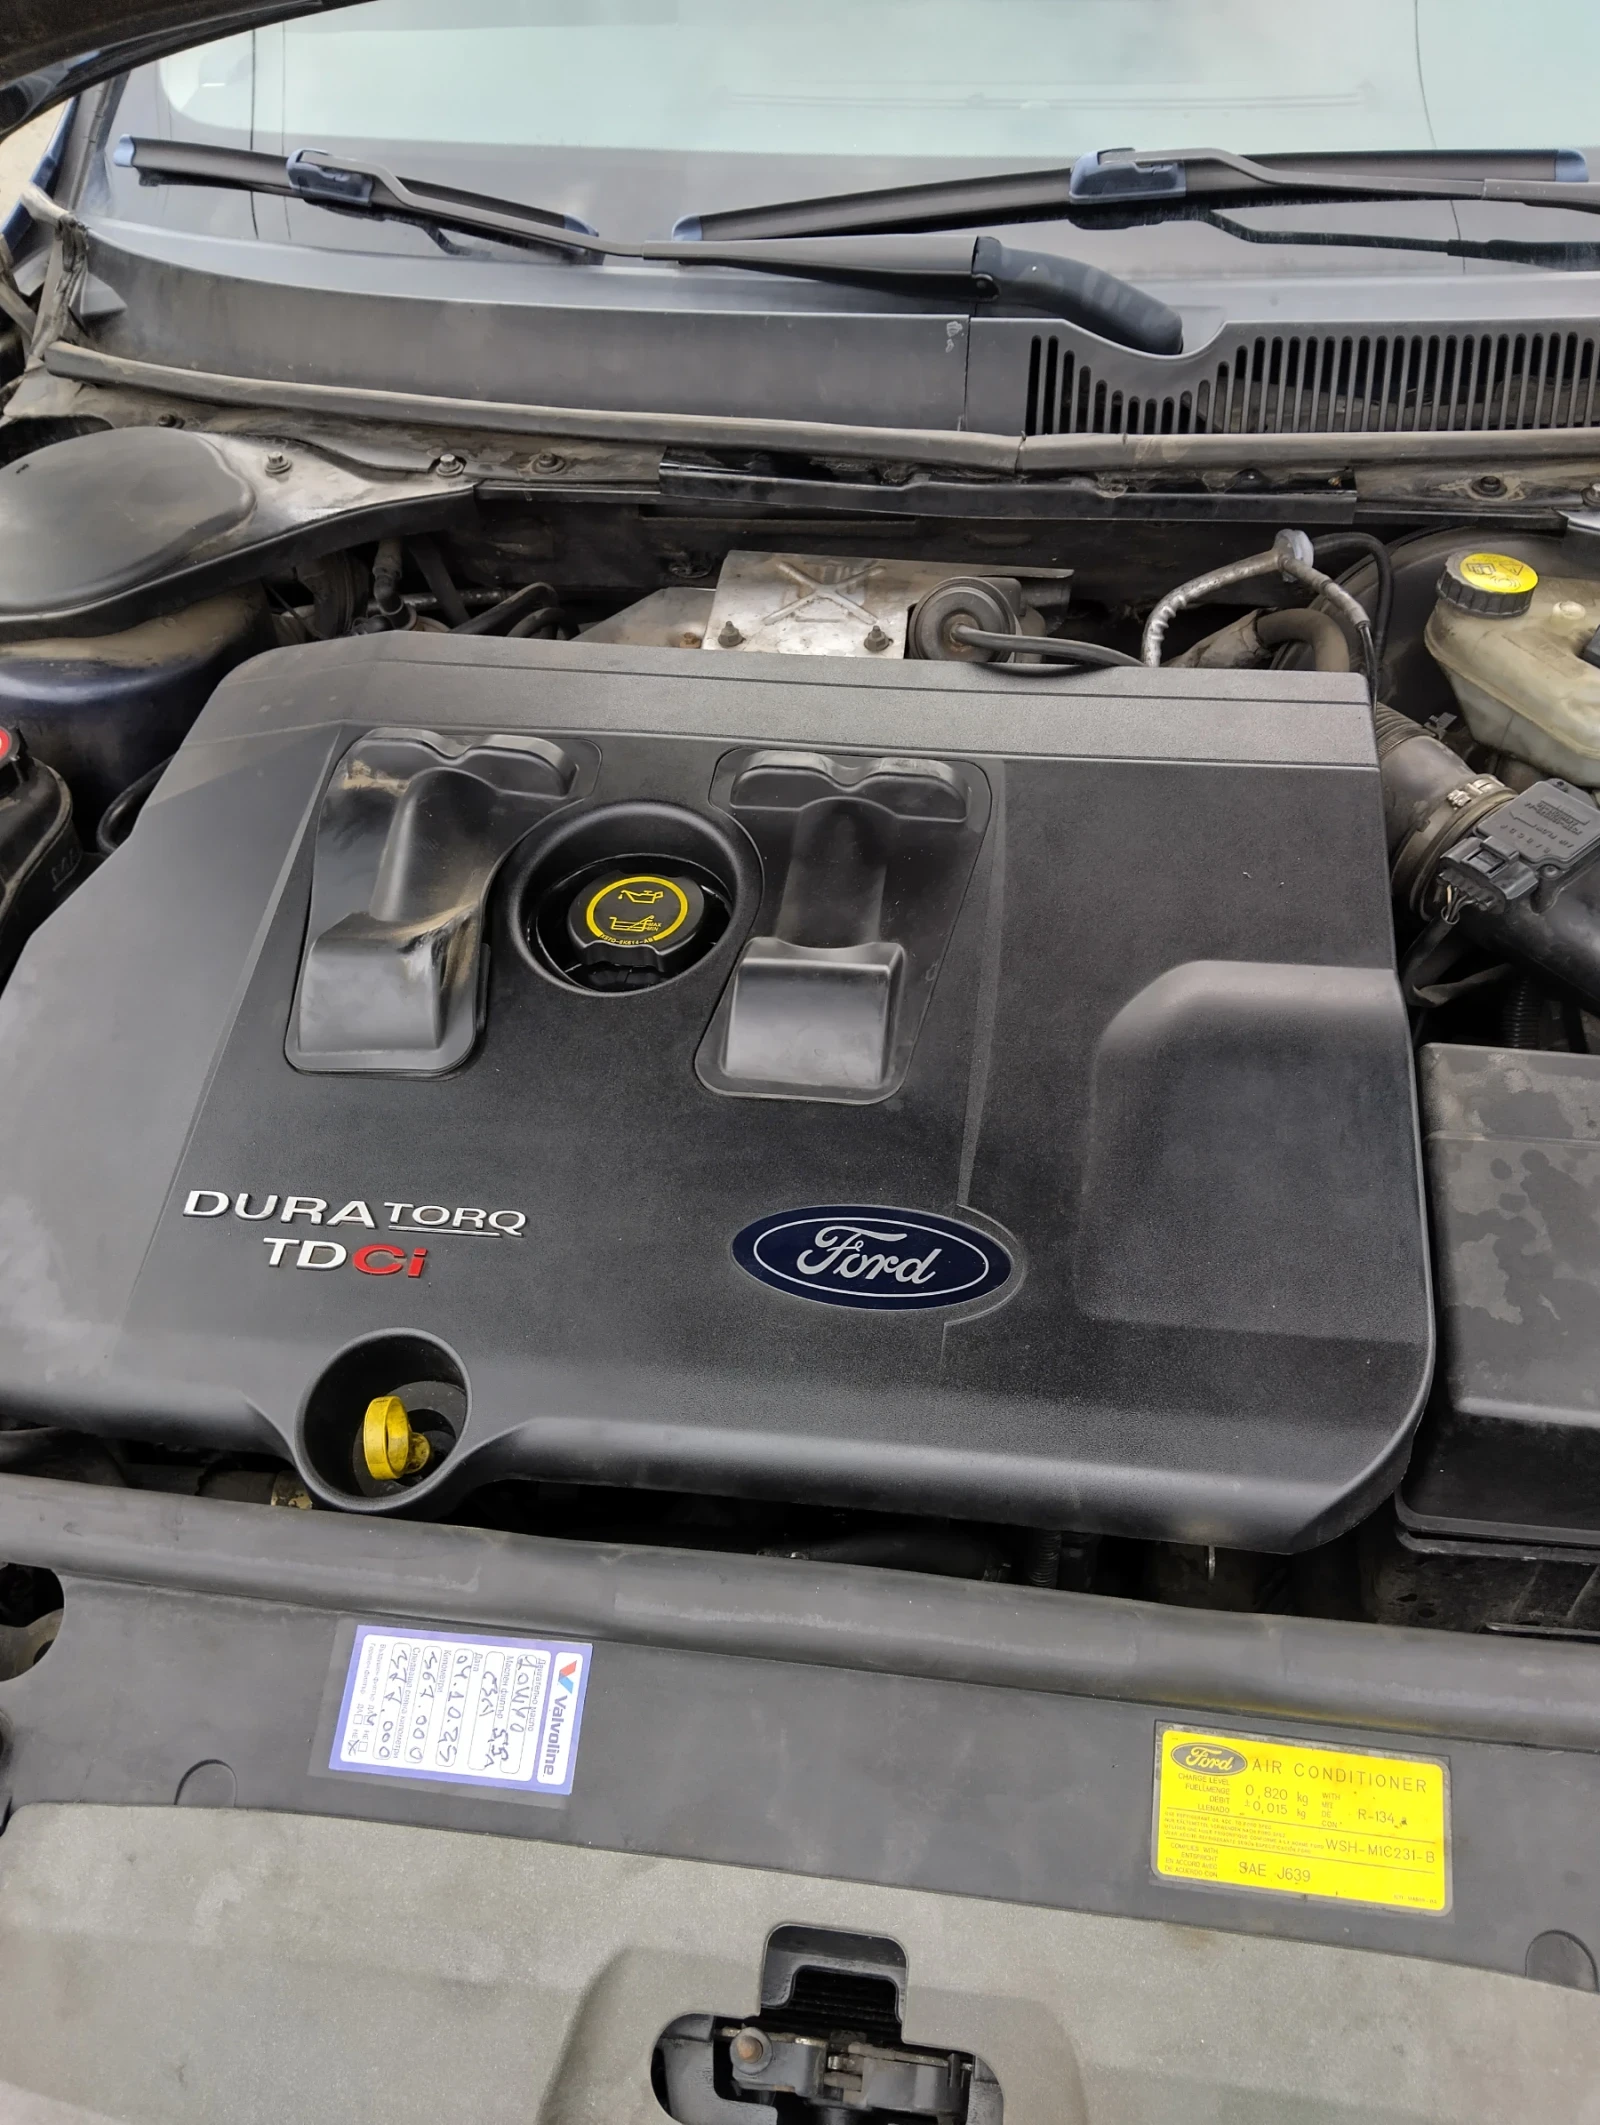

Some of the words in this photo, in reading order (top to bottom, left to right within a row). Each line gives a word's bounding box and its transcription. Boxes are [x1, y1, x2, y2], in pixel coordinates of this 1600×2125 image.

[263, 1237, 428, 1278] TDCi
[796, 1226, 942, 1284] Ford
[473, 1652, 483, 1672] Дата
[502, 1656, 514, 1686] Маслен
[544, 1695, 568, 1776] Valvoline
[1186, 1746, 1235, 1771] Ford
[1178, 1772, 1207, 1782] CHARGE
[1209, 1777, 1230, 1785] LEVEL
[1252, 1758, 1282, 1774] AIR
[1294, 1763, 1427, 1793] CONDITIONER
[1185, 1783, 1231, 1795] FUELLMENGE
[1297, 1791, 1308, 1806] kg
[1197, 1804, 1230, 1813] LLENADO
[1296, 1808, 1306, 1819] kg
[1321, 1820, 1338, 1828] CON
[1165, 1857, 1175, 1865] EN
[1176, 1859, 1201, 1868] ACCORD
[1202, 1862, 1218, 1870] AVEC
[1239, 1861, 1267, 1877] SAE
[1277, 1867, 1311, 1882] J639
[1204, 1870, 1218, 1878] CON
